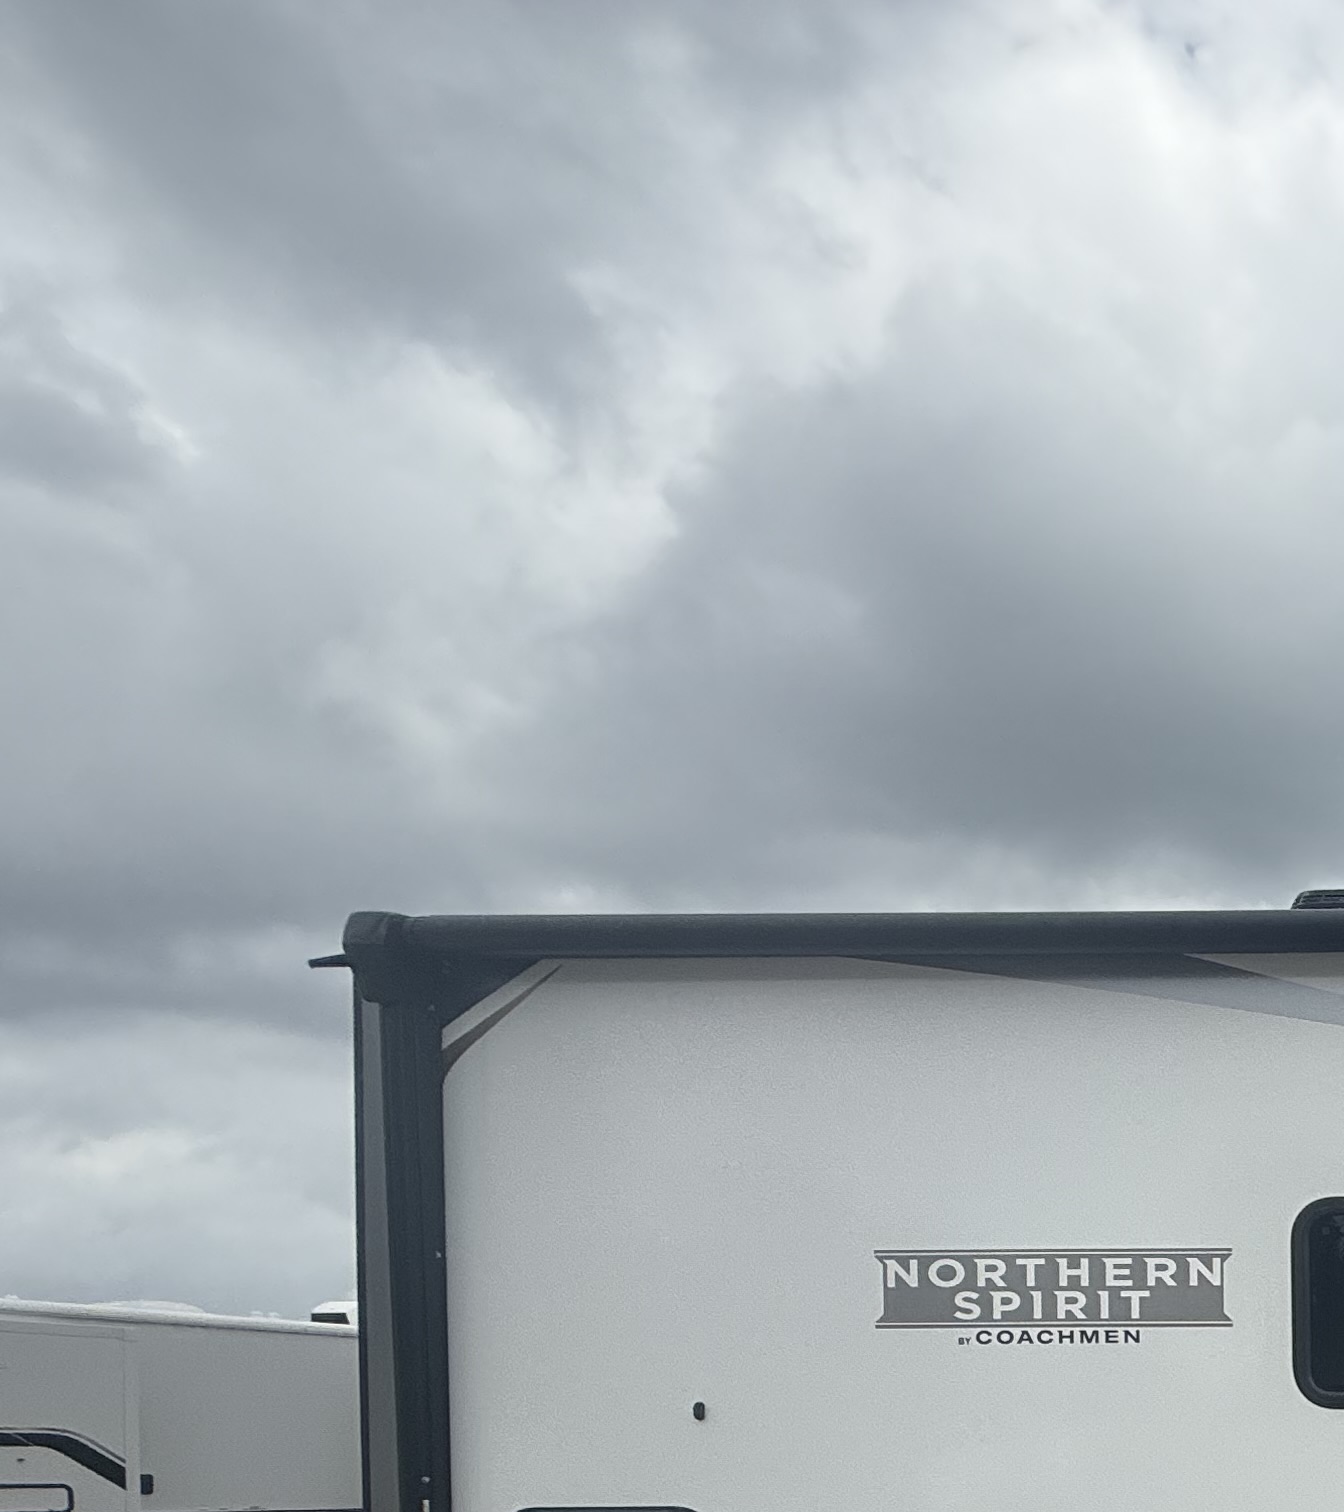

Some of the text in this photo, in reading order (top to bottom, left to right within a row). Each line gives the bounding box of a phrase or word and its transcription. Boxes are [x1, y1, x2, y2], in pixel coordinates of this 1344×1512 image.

[884, 1256, 1222, 1288] NORTHERN
[953, 1289, 1151, 1320] SPIRIT
[957, 1328, 1141, 1346] BY COACHMEN
